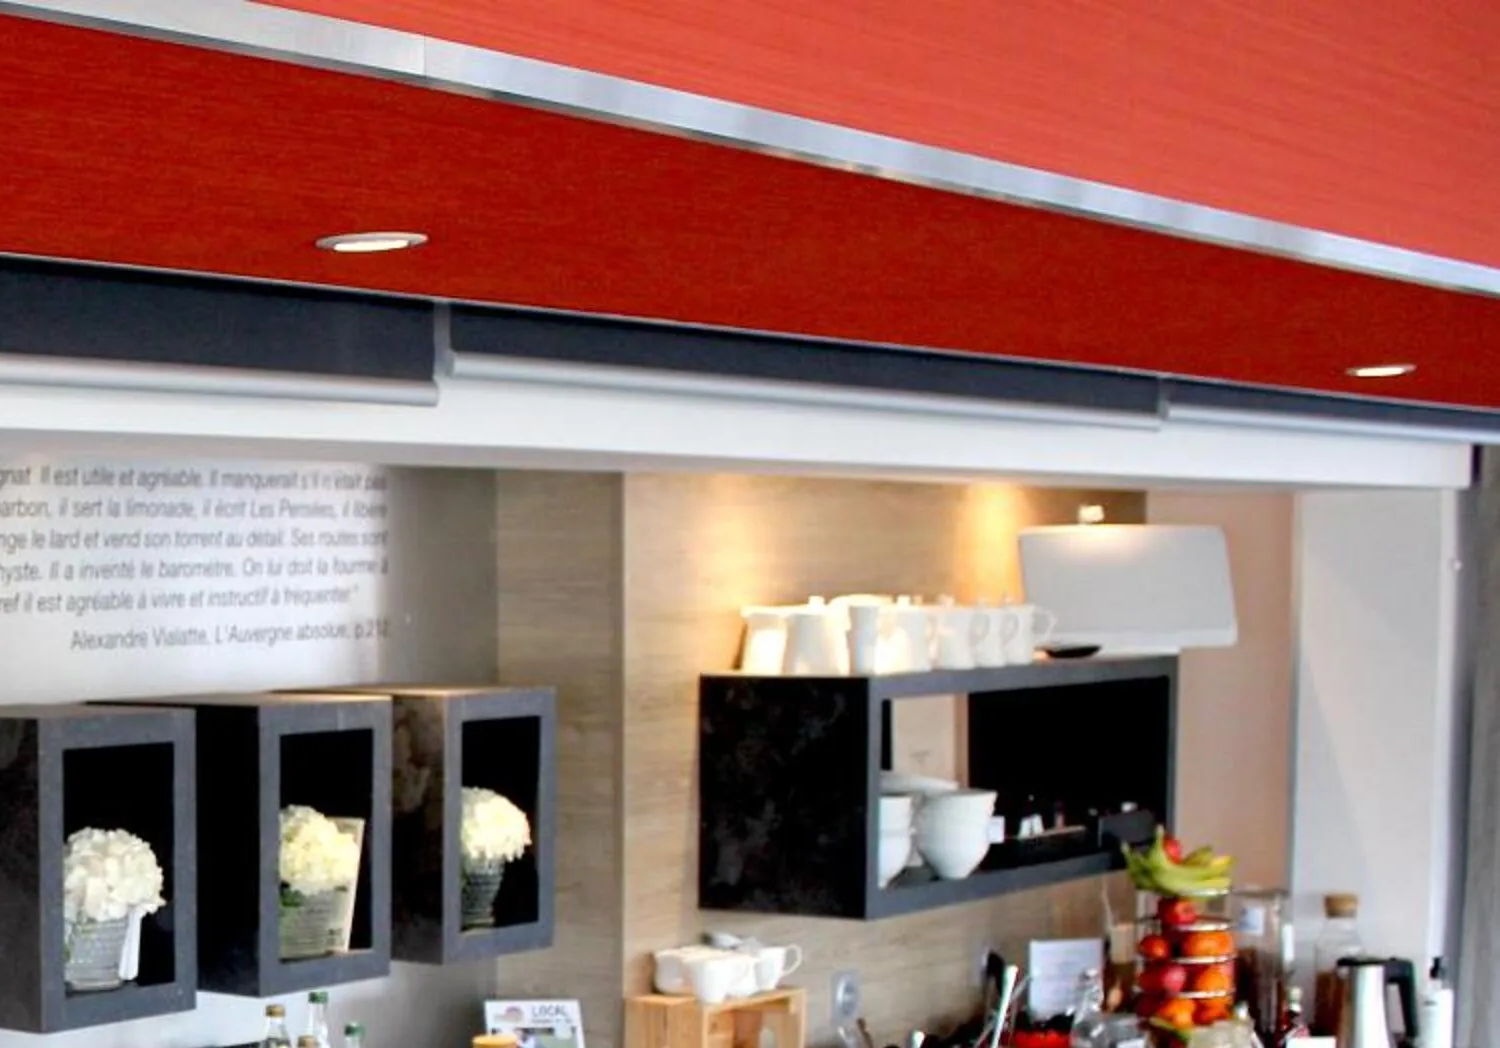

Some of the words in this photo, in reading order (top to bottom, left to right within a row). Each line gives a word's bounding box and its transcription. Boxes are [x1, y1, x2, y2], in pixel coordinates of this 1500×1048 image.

[53, 467, 79, 487] est
[118, 467, 135, 487] et
[72, 498, 103, 518] sert
[31, 528, 47, 549] le
[51, 527, 81, 549] lard
[83, 529, 100, 549] et
[103, 528, 141, 549] vend
[143, 531, 172, 549] son
[64, 563, 75, 581] a
[79, 559, 136, 581] inventé
[139, 558, 155, 579] le
[36, 594, 63, 612] est
[151, 590, 186, 609] vivre
[189, 589, 205, 609] et
[70, 627, 150, 651] Alexandre
